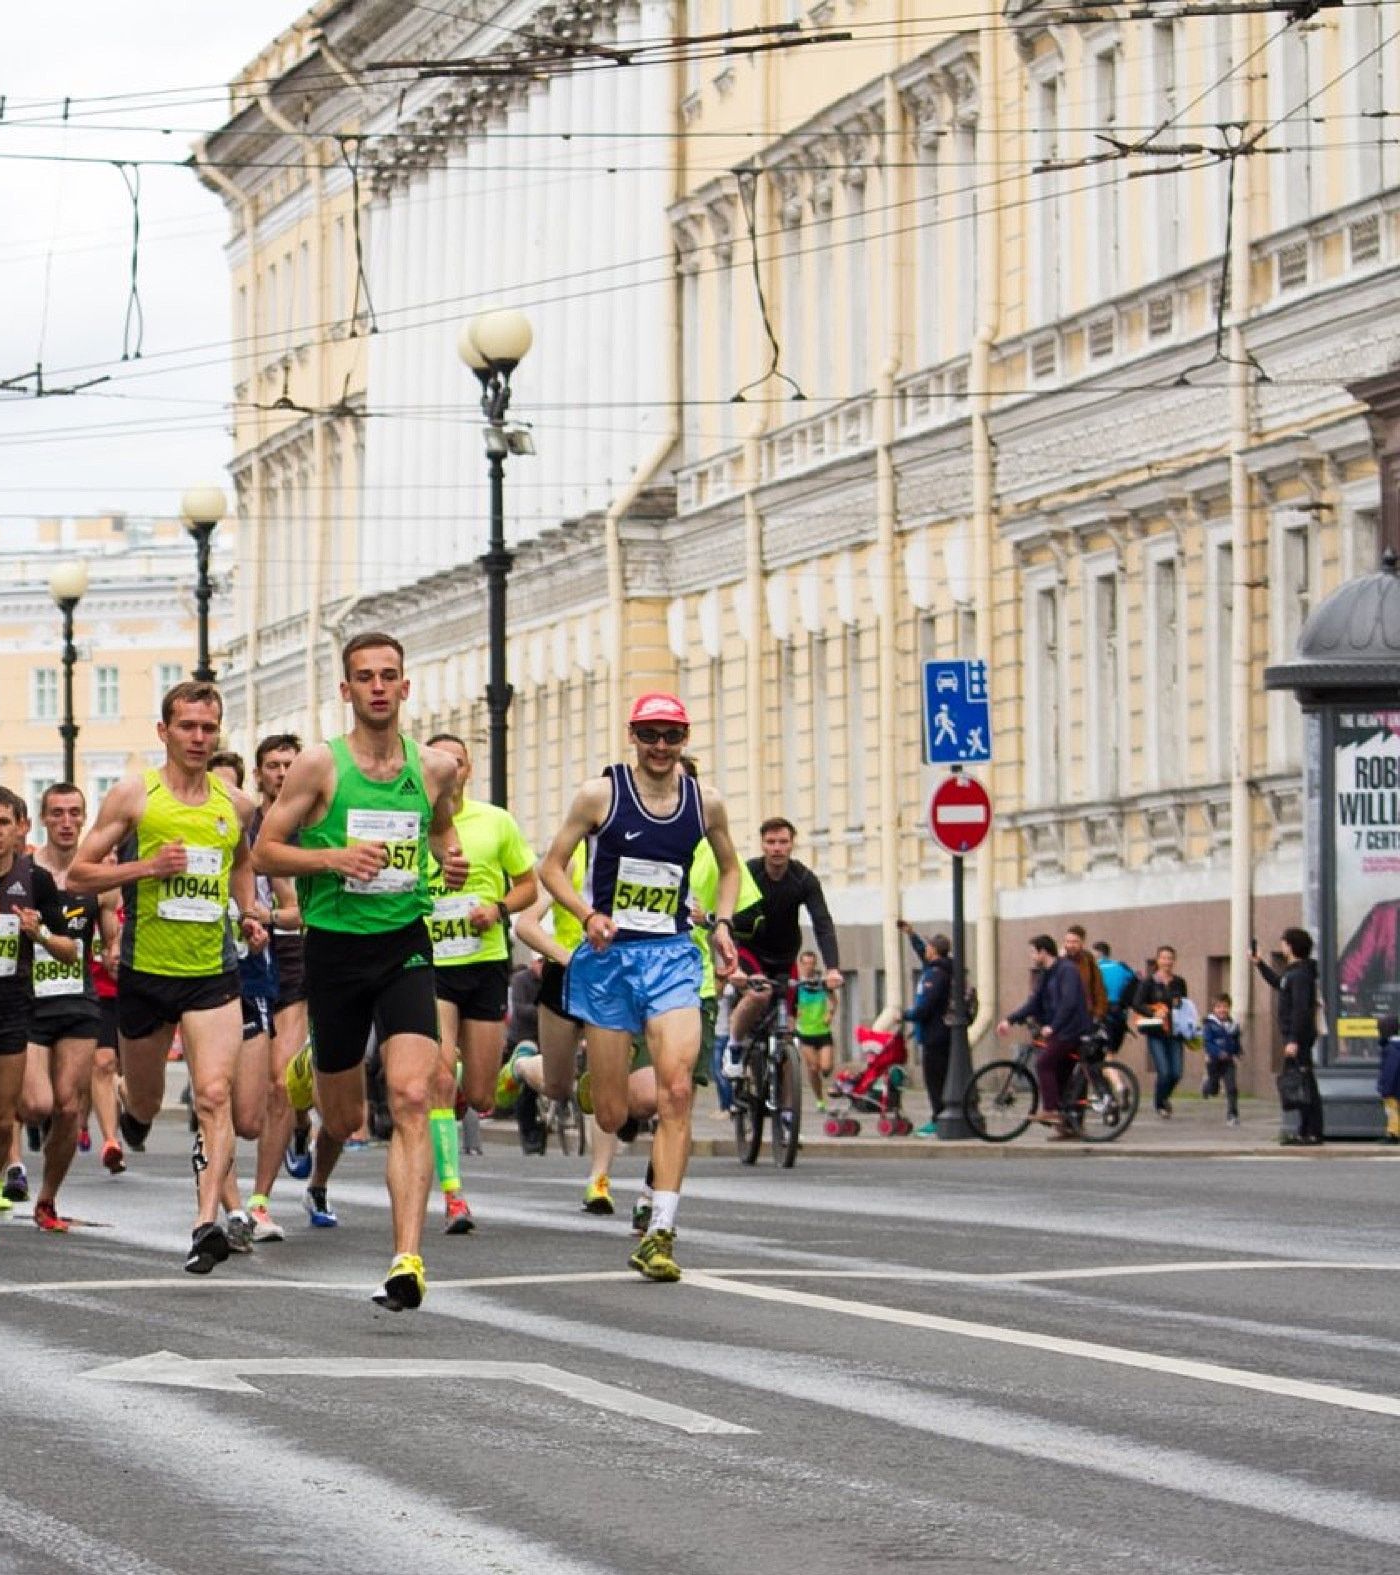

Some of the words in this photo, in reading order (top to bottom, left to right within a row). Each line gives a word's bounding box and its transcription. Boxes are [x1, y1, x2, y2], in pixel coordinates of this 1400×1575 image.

[1355, 756, 1400, 789] ROB
[1339, 792, 1400, 825] WILLI
[164, 876, 220, 900] 10944
[616, 884, 677, 914] 5427
